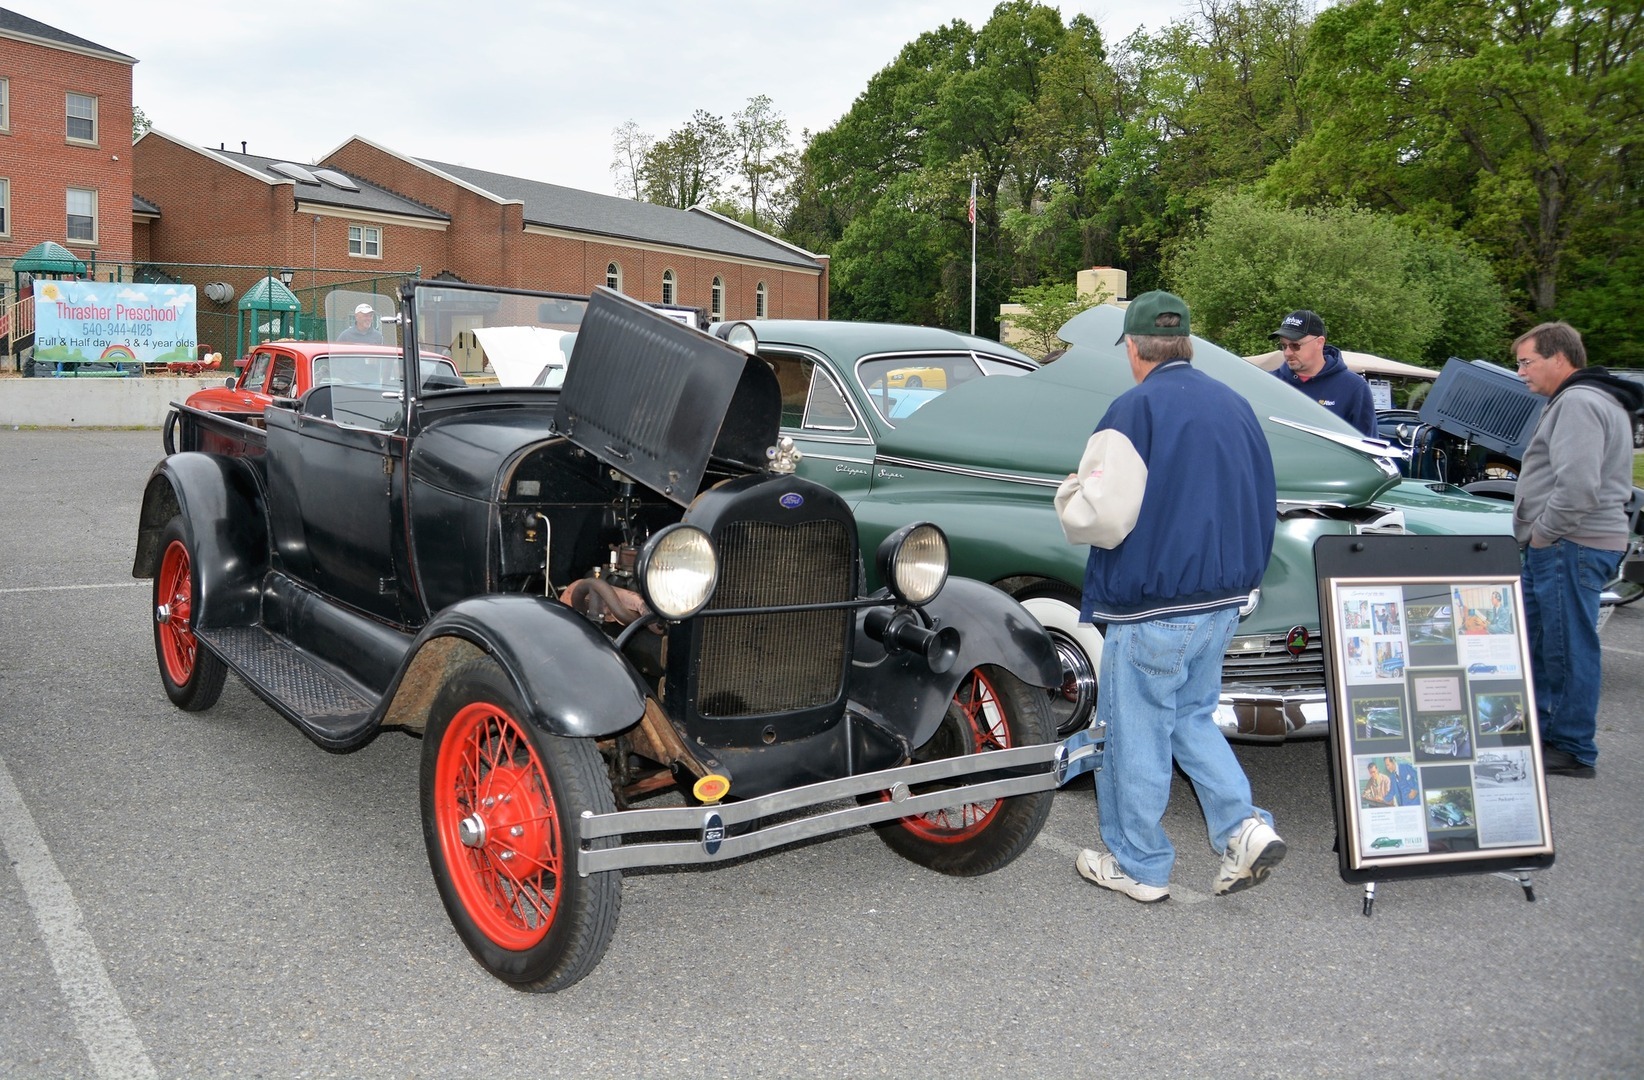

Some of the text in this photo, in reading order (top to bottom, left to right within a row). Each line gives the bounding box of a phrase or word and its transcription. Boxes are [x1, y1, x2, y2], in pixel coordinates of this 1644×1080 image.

[56, 302, 176, 321] Thrasher Preschool
[82, 322, 152, 336] 540-344-4125
[38, 337, 195, 350] Full & Half day 3 & 4 year olds
[835, 464, 868, 475] Clipper
[877, 469, 904, 479] Super
[783, 495, 801, 505] Ford
